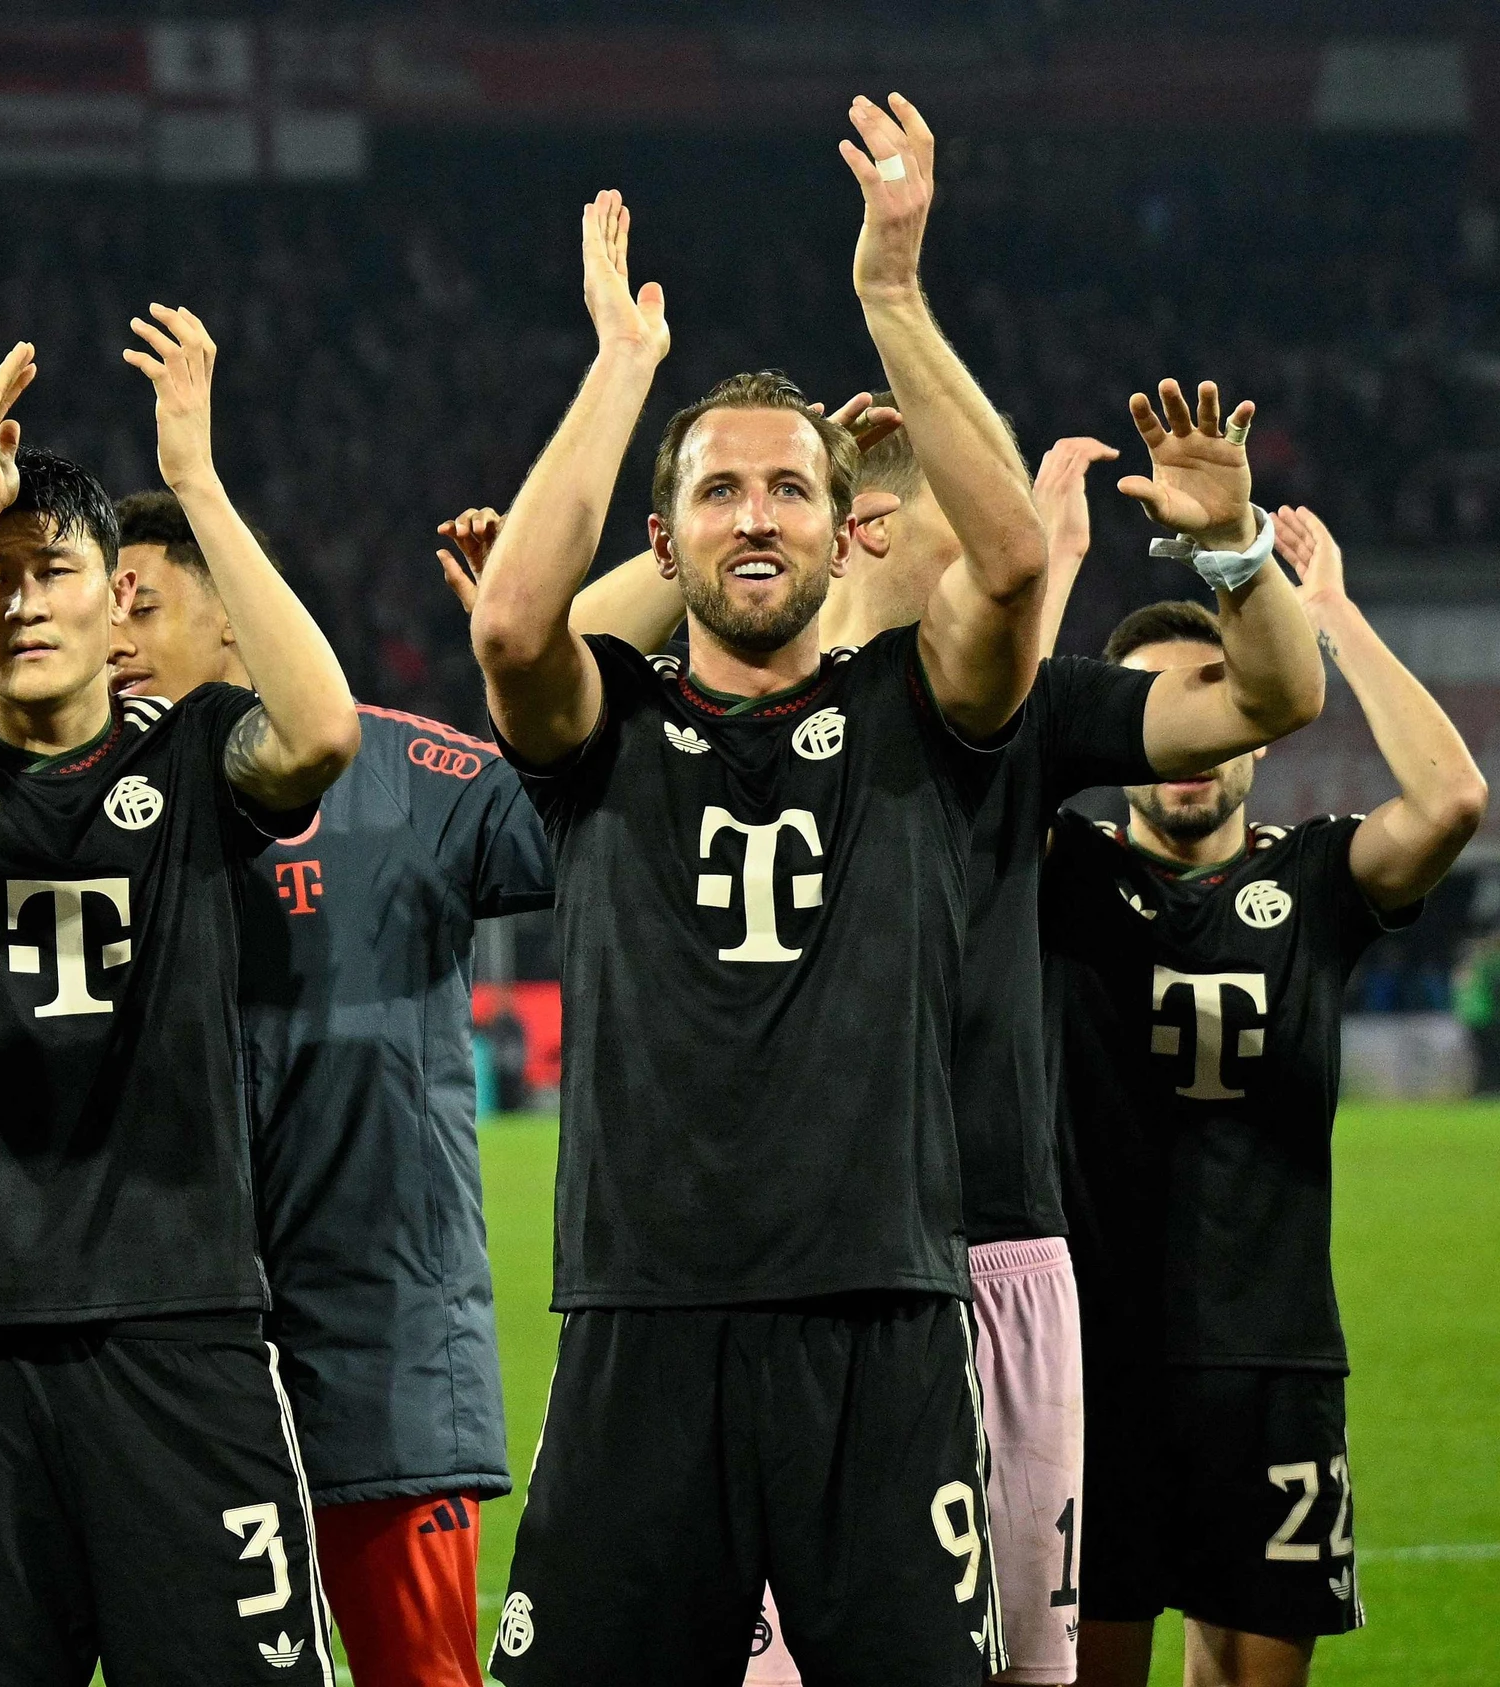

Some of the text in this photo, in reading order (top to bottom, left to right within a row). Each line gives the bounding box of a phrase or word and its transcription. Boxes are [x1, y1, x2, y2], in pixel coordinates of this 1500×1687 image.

[275, 859, 323, 915] T
[696, 805, 824, 963] T
[6, 877, 131, 1019] T
[1150, 966, 1268, 1101] T
[223, 1502, 291, 1617] 3
[930, 1480, 982, 1604] 9
[1050, 1497, 1077, 1608] 1
[1265, 1454, 1353, 1561] 22
